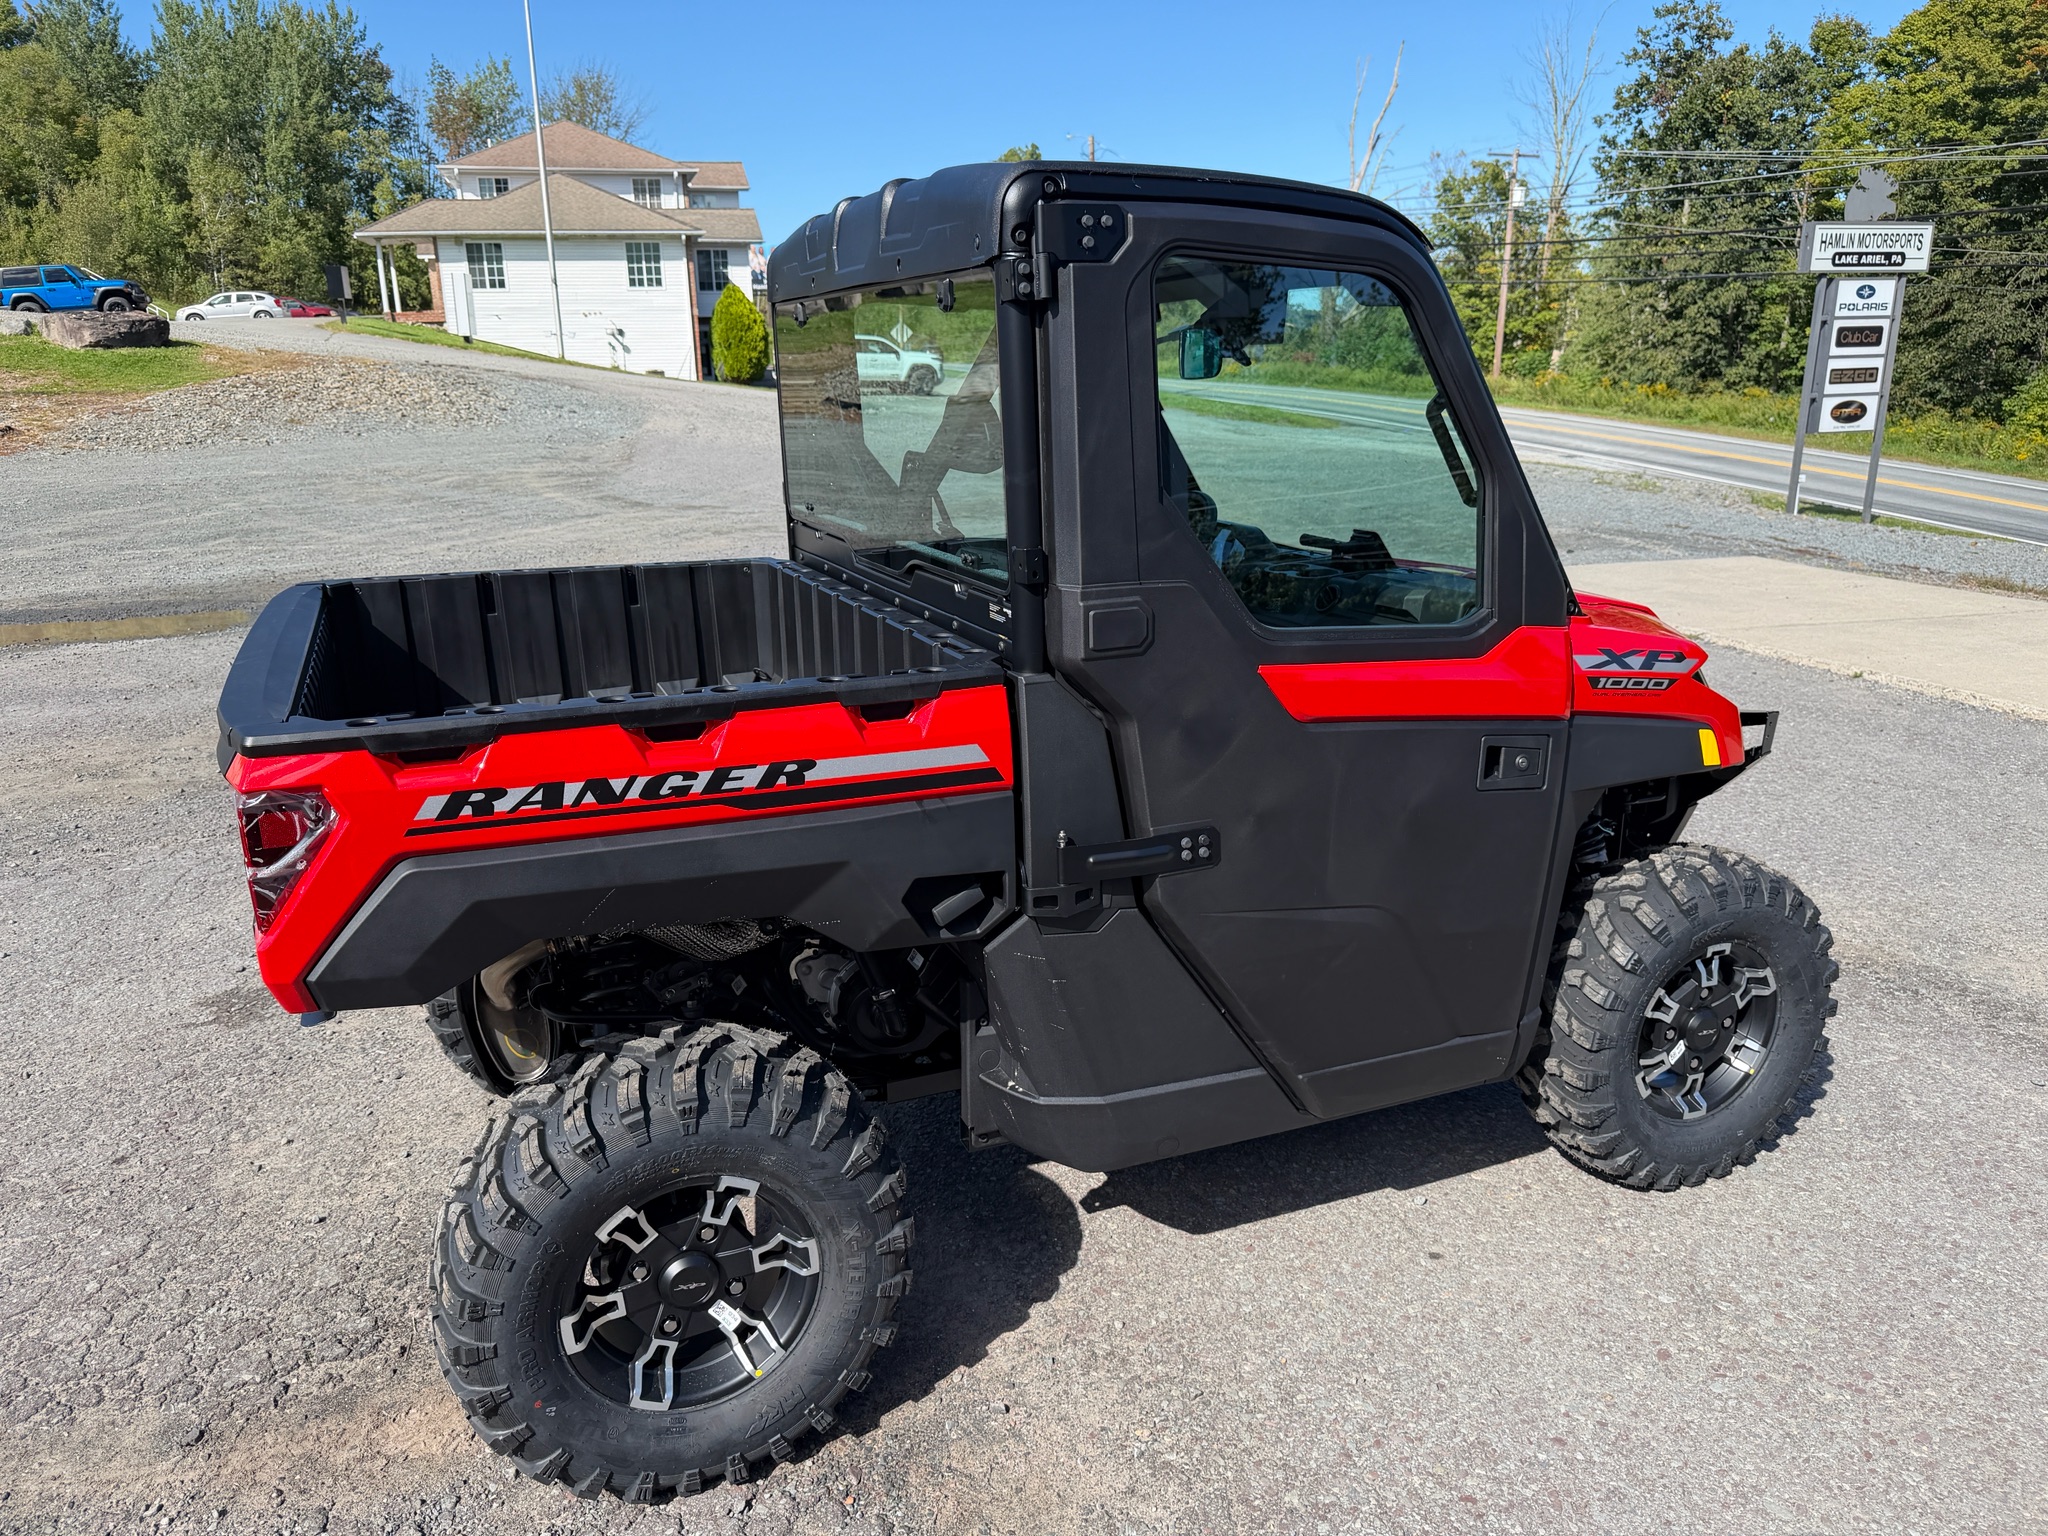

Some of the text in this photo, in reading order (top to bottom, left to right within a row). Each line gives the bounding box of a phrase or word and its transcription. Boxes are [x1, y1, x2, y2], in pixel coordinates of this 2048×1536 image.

[1819, 232, 1924, 252] HAMLIN MOTORSPORTS
[1834, 254, 1903, 266] LAKE ARIEL, PA
[1839, 302, 1888, 311] POLARIS
[1840, 330, 1878, 343] Club Car
[1585, 647, 1688, 671] XP
[1597, 677, 1670, 690] 1000
[433, 758, 818, 822] RANGER
[673, 1282, 707, 1292] XP
[515, 1259, 547, 1394] PRO ARMOR
